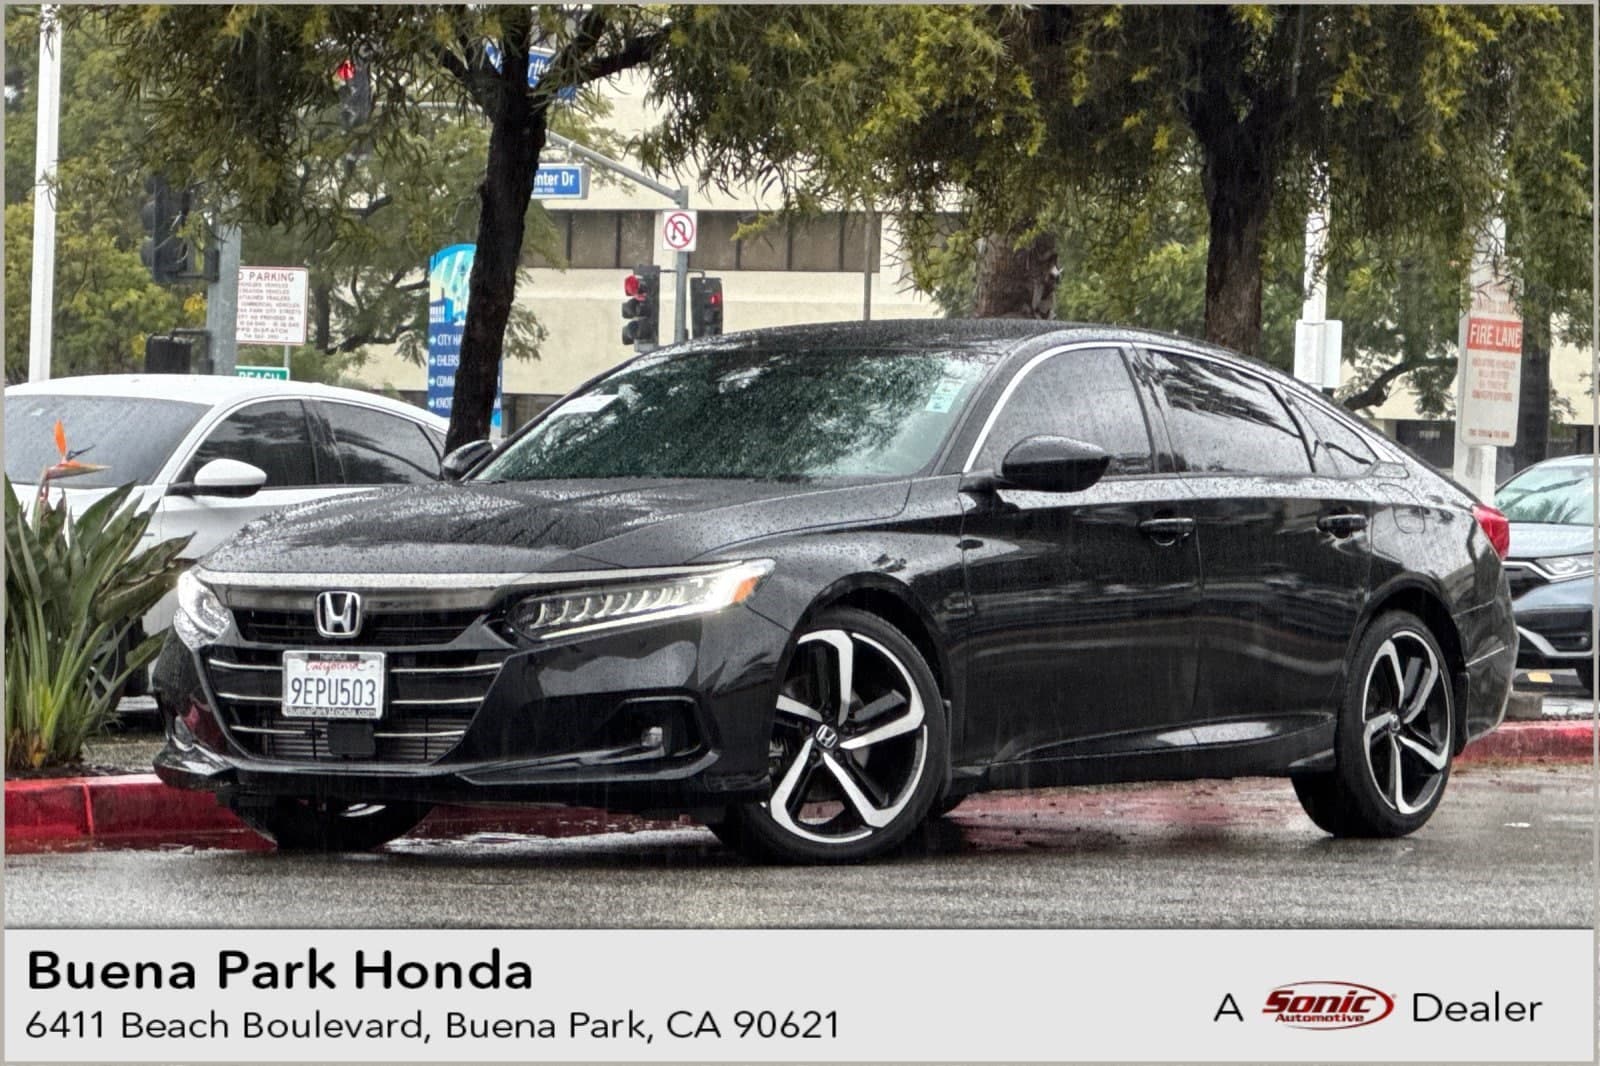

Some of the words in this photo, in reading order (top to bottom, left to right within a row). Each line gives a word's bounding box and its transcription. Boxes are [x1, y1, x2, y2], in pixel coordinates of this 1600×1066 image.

[534, 171, 559, 186] nter
[561, 171, 575, 186] Dr
[249, 272, 295, 282] PARKING
[437, 334, 452, 345] CITY
[1469, 323, 1494, 345] FIRE
[1495, 325, 1521, 348] LANE
[291, 677, 376, 706] 9EPU503
